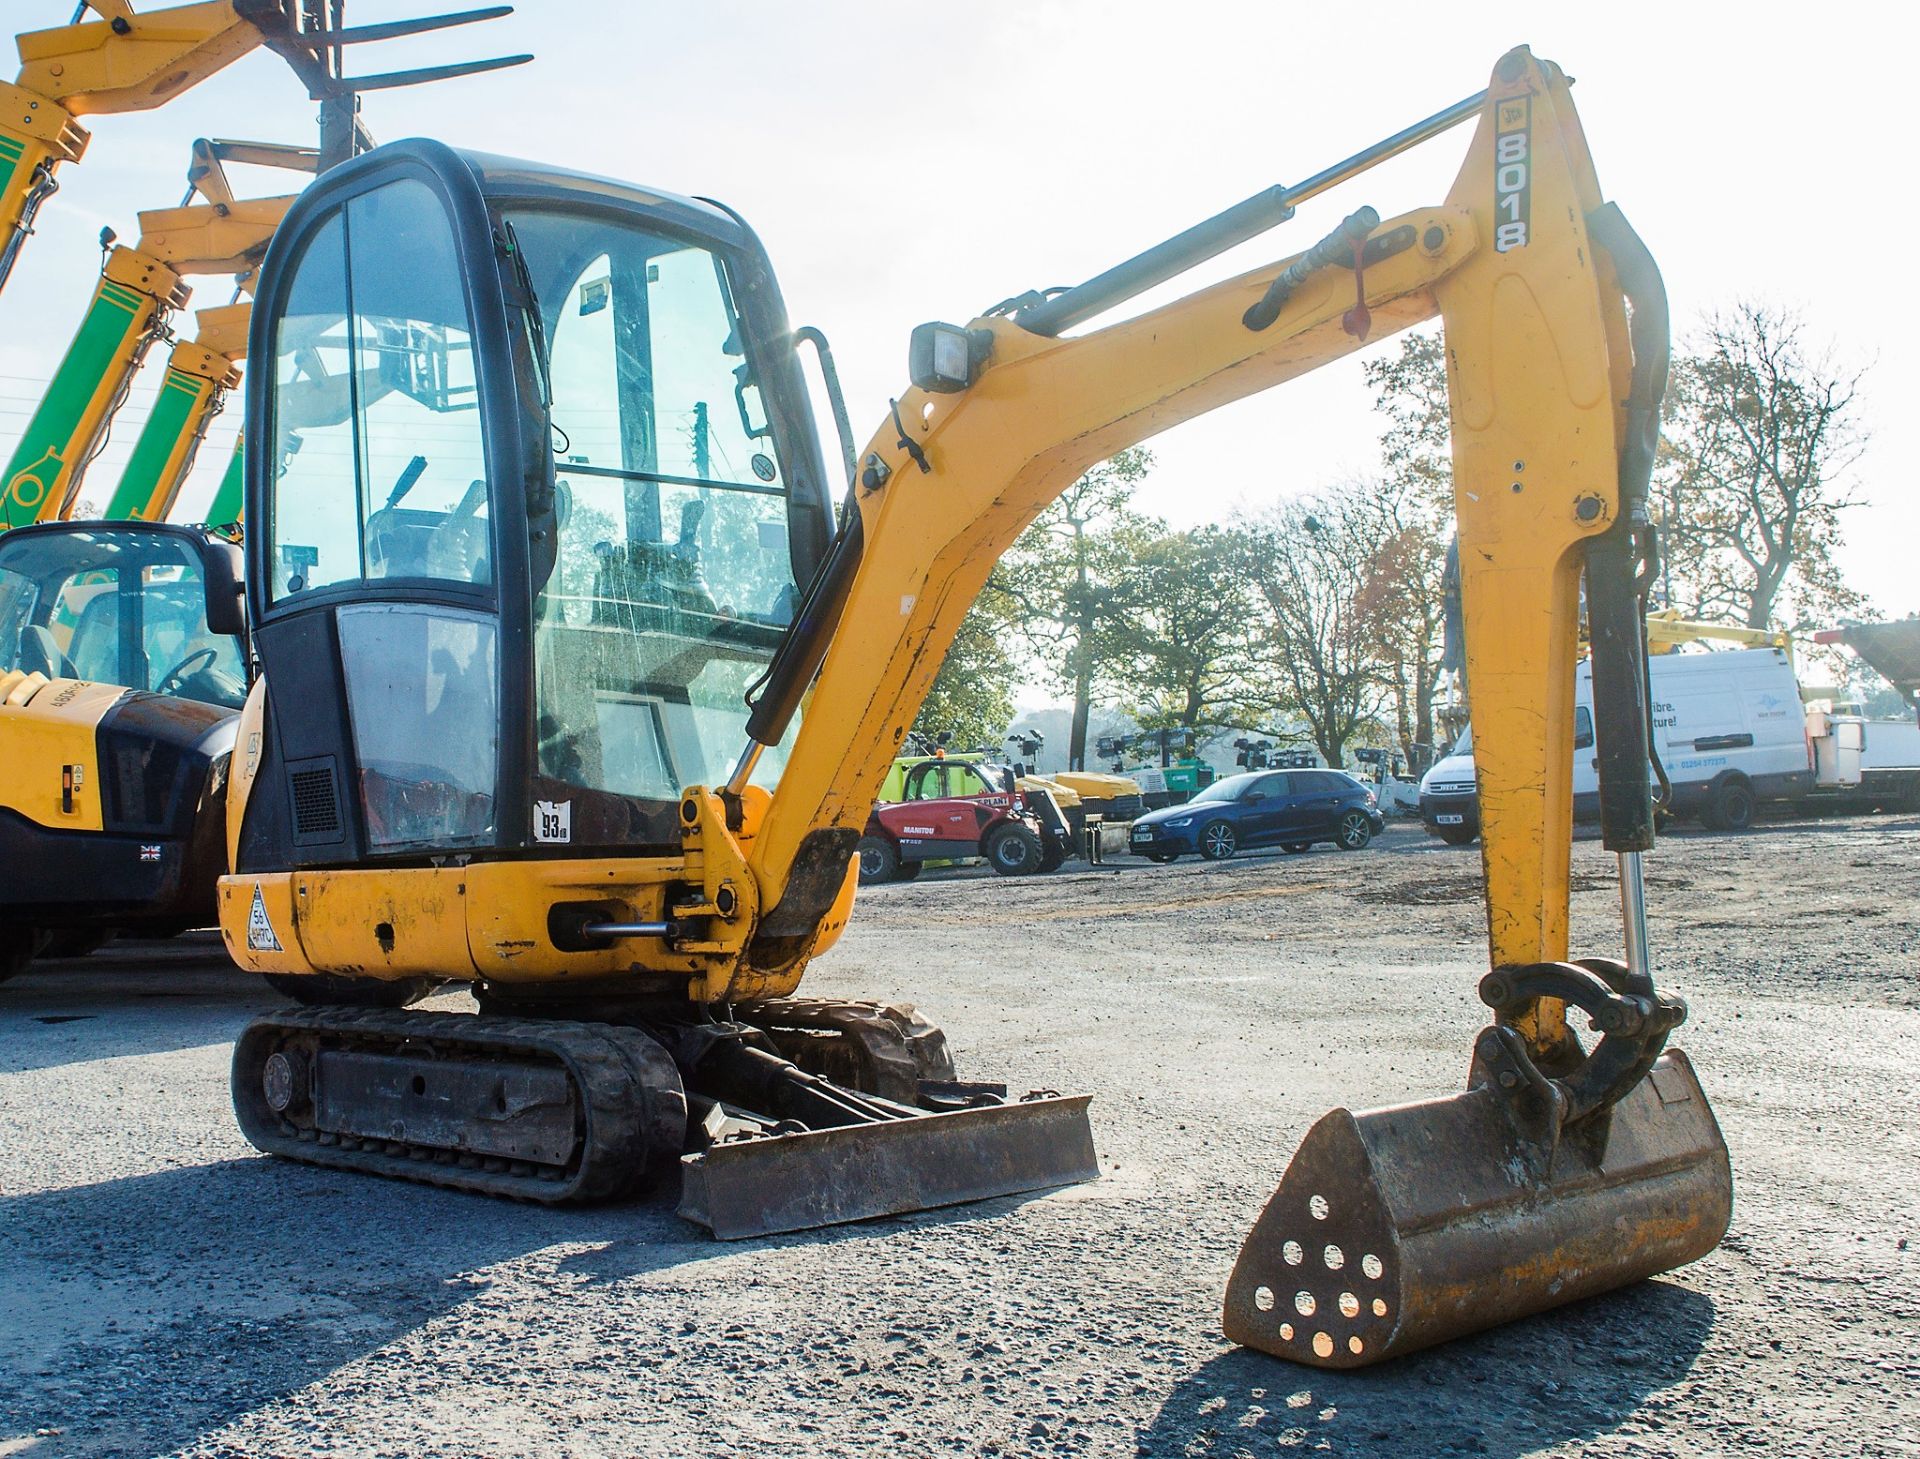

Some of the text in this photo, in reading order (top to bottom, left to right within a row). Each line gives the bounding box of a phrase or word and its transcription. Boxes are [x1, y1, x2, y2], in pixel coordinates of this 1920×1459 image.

[1496, 132, 1527, 252] 8018
[1653, 701, 1675, 712] ibre.
[1654, 715, 1676, 728] ture!
[542, 814, 560, 838] 93
[903, 826, 935, 835] MANITOU
[253, 910, 264, 925] 56
